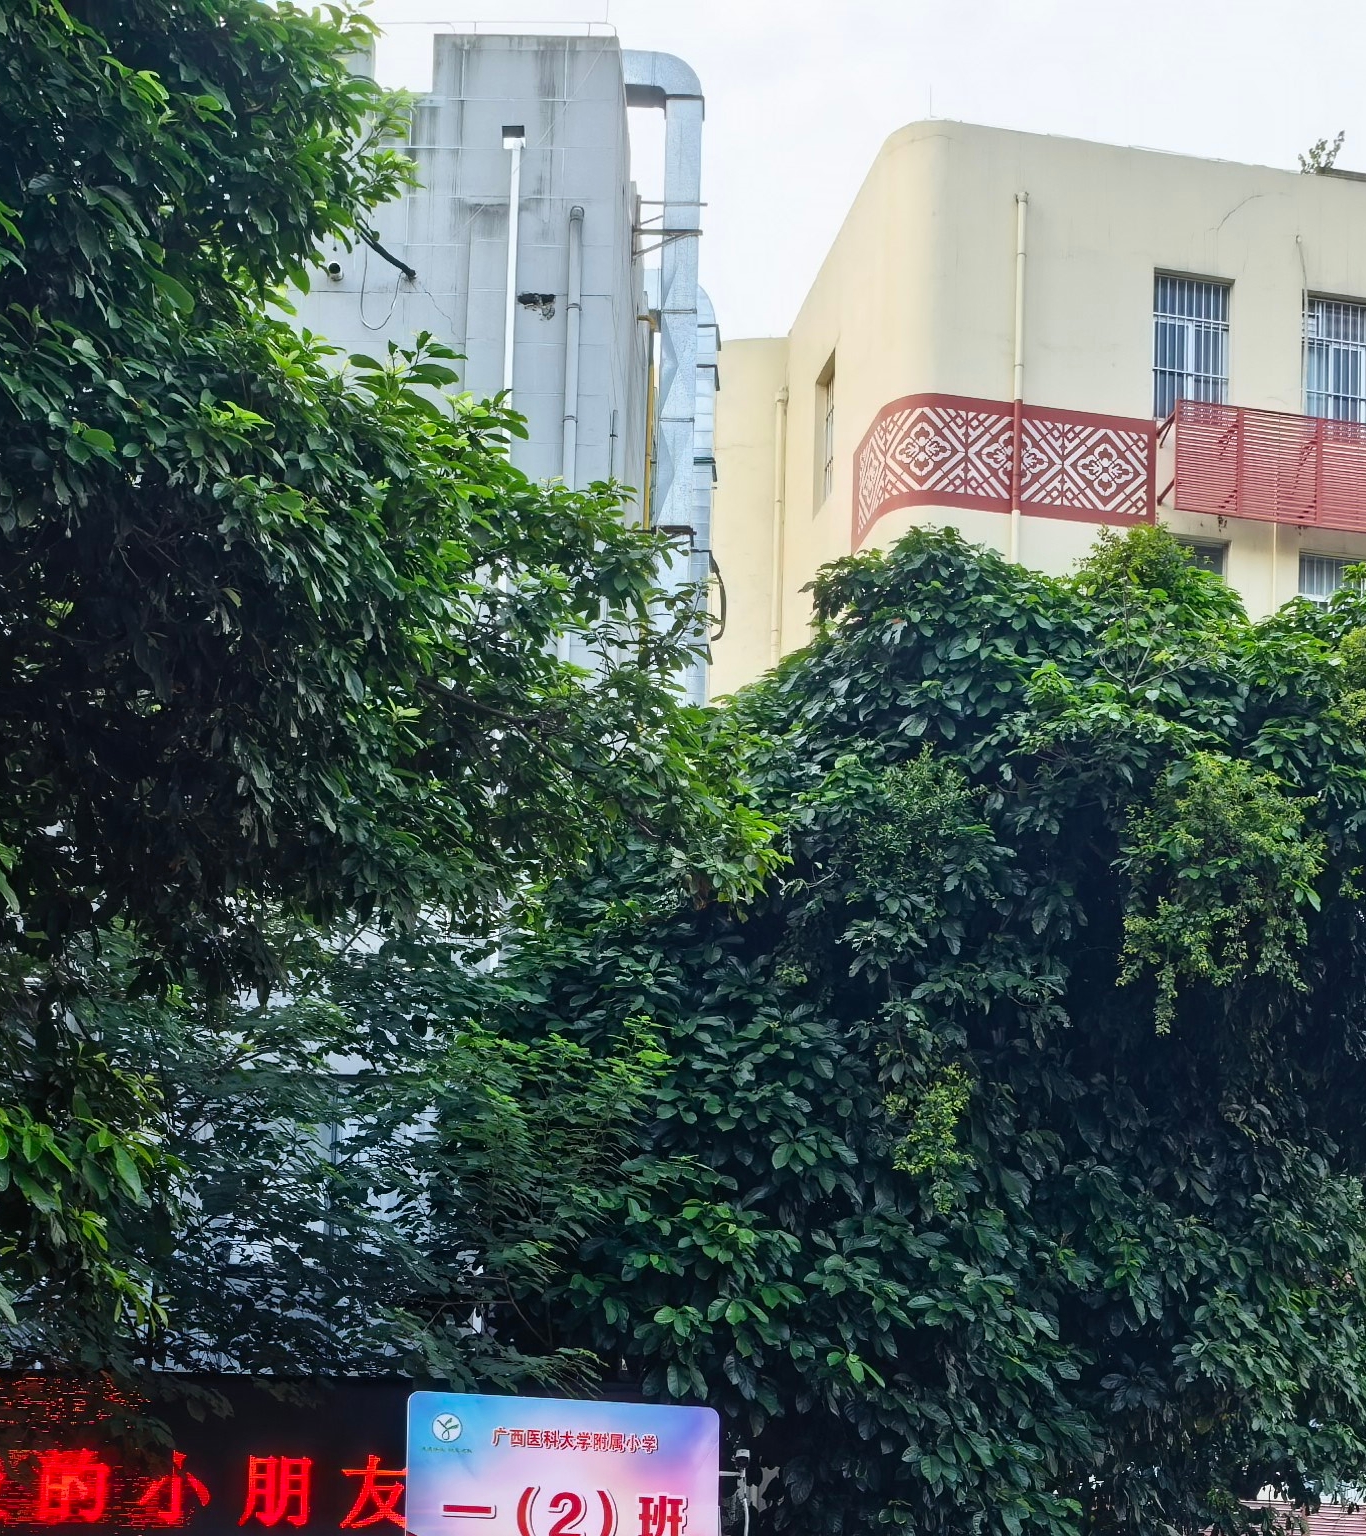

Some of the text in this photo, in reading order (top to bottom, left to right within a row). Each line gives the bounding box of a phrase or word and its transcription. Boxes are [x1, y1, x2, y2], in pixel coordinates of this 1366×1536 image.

[492, 1427, 658, 1453] 广西医科大学附属小学
